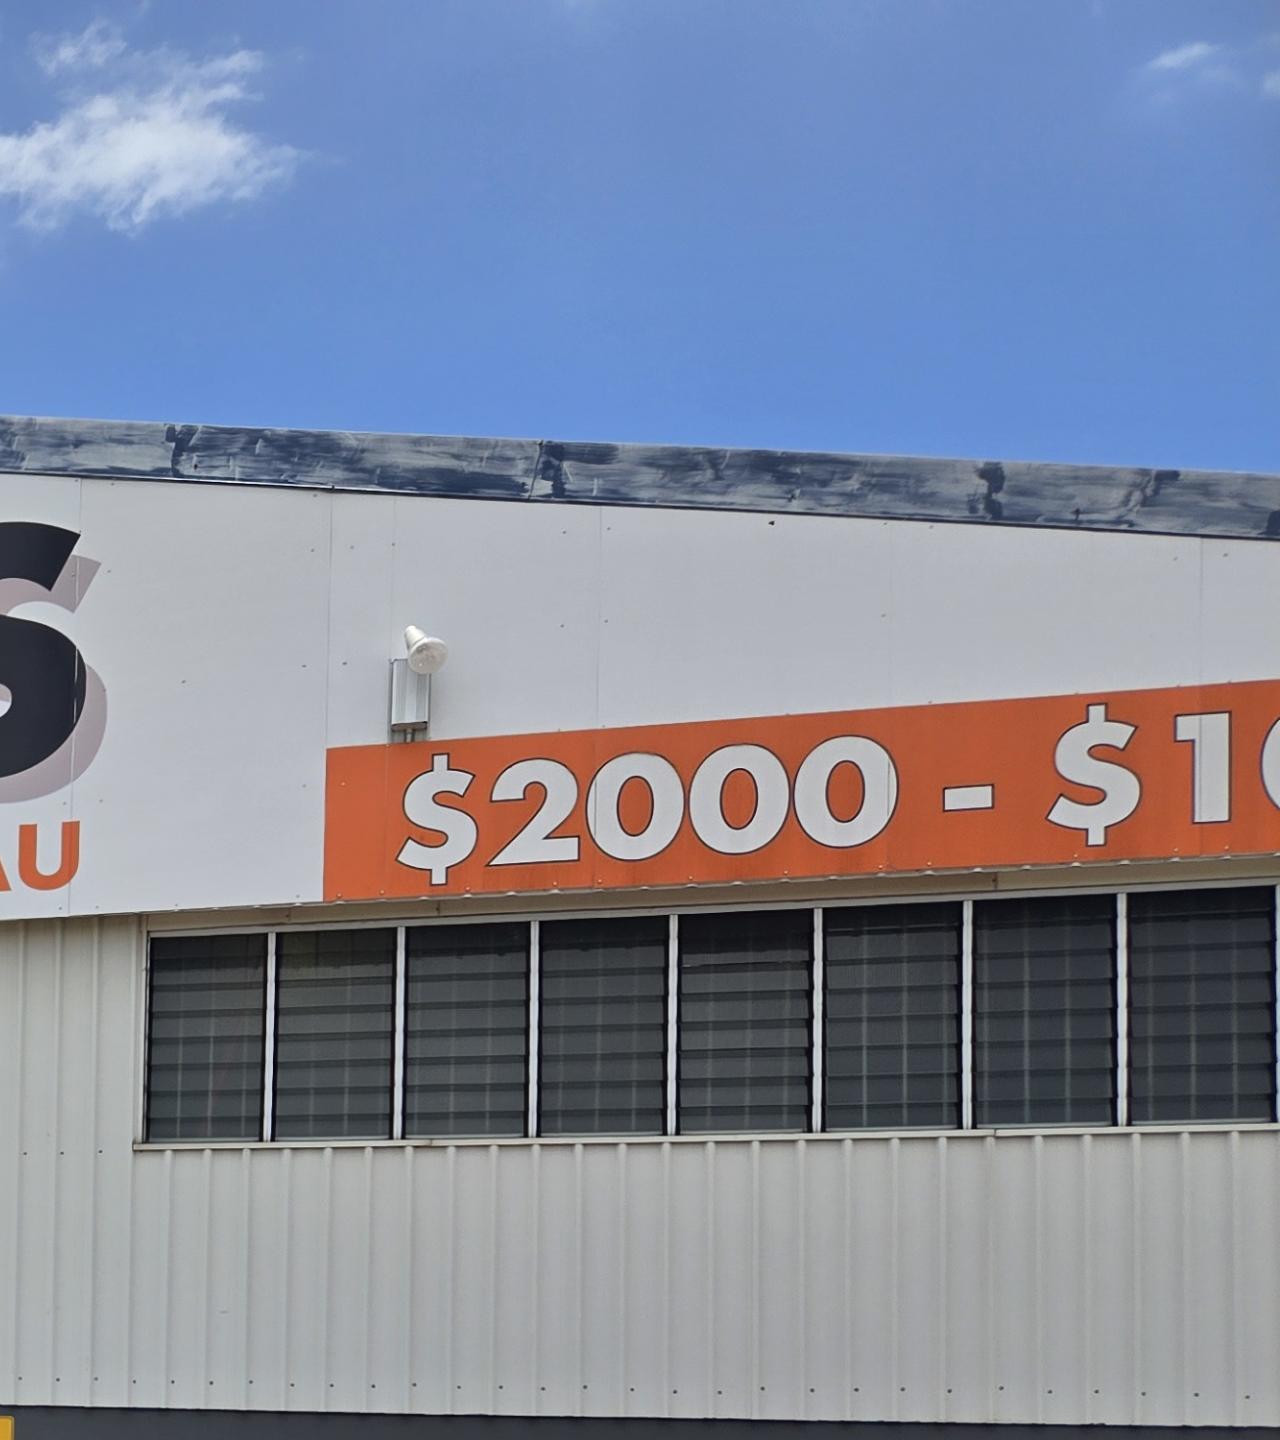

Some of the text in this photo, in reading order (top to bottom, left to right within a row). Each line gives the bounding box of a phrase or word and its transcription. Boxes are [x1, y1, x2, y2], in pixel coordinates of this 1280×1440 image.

[394, 701, 1280, 887] $2000 - $1
